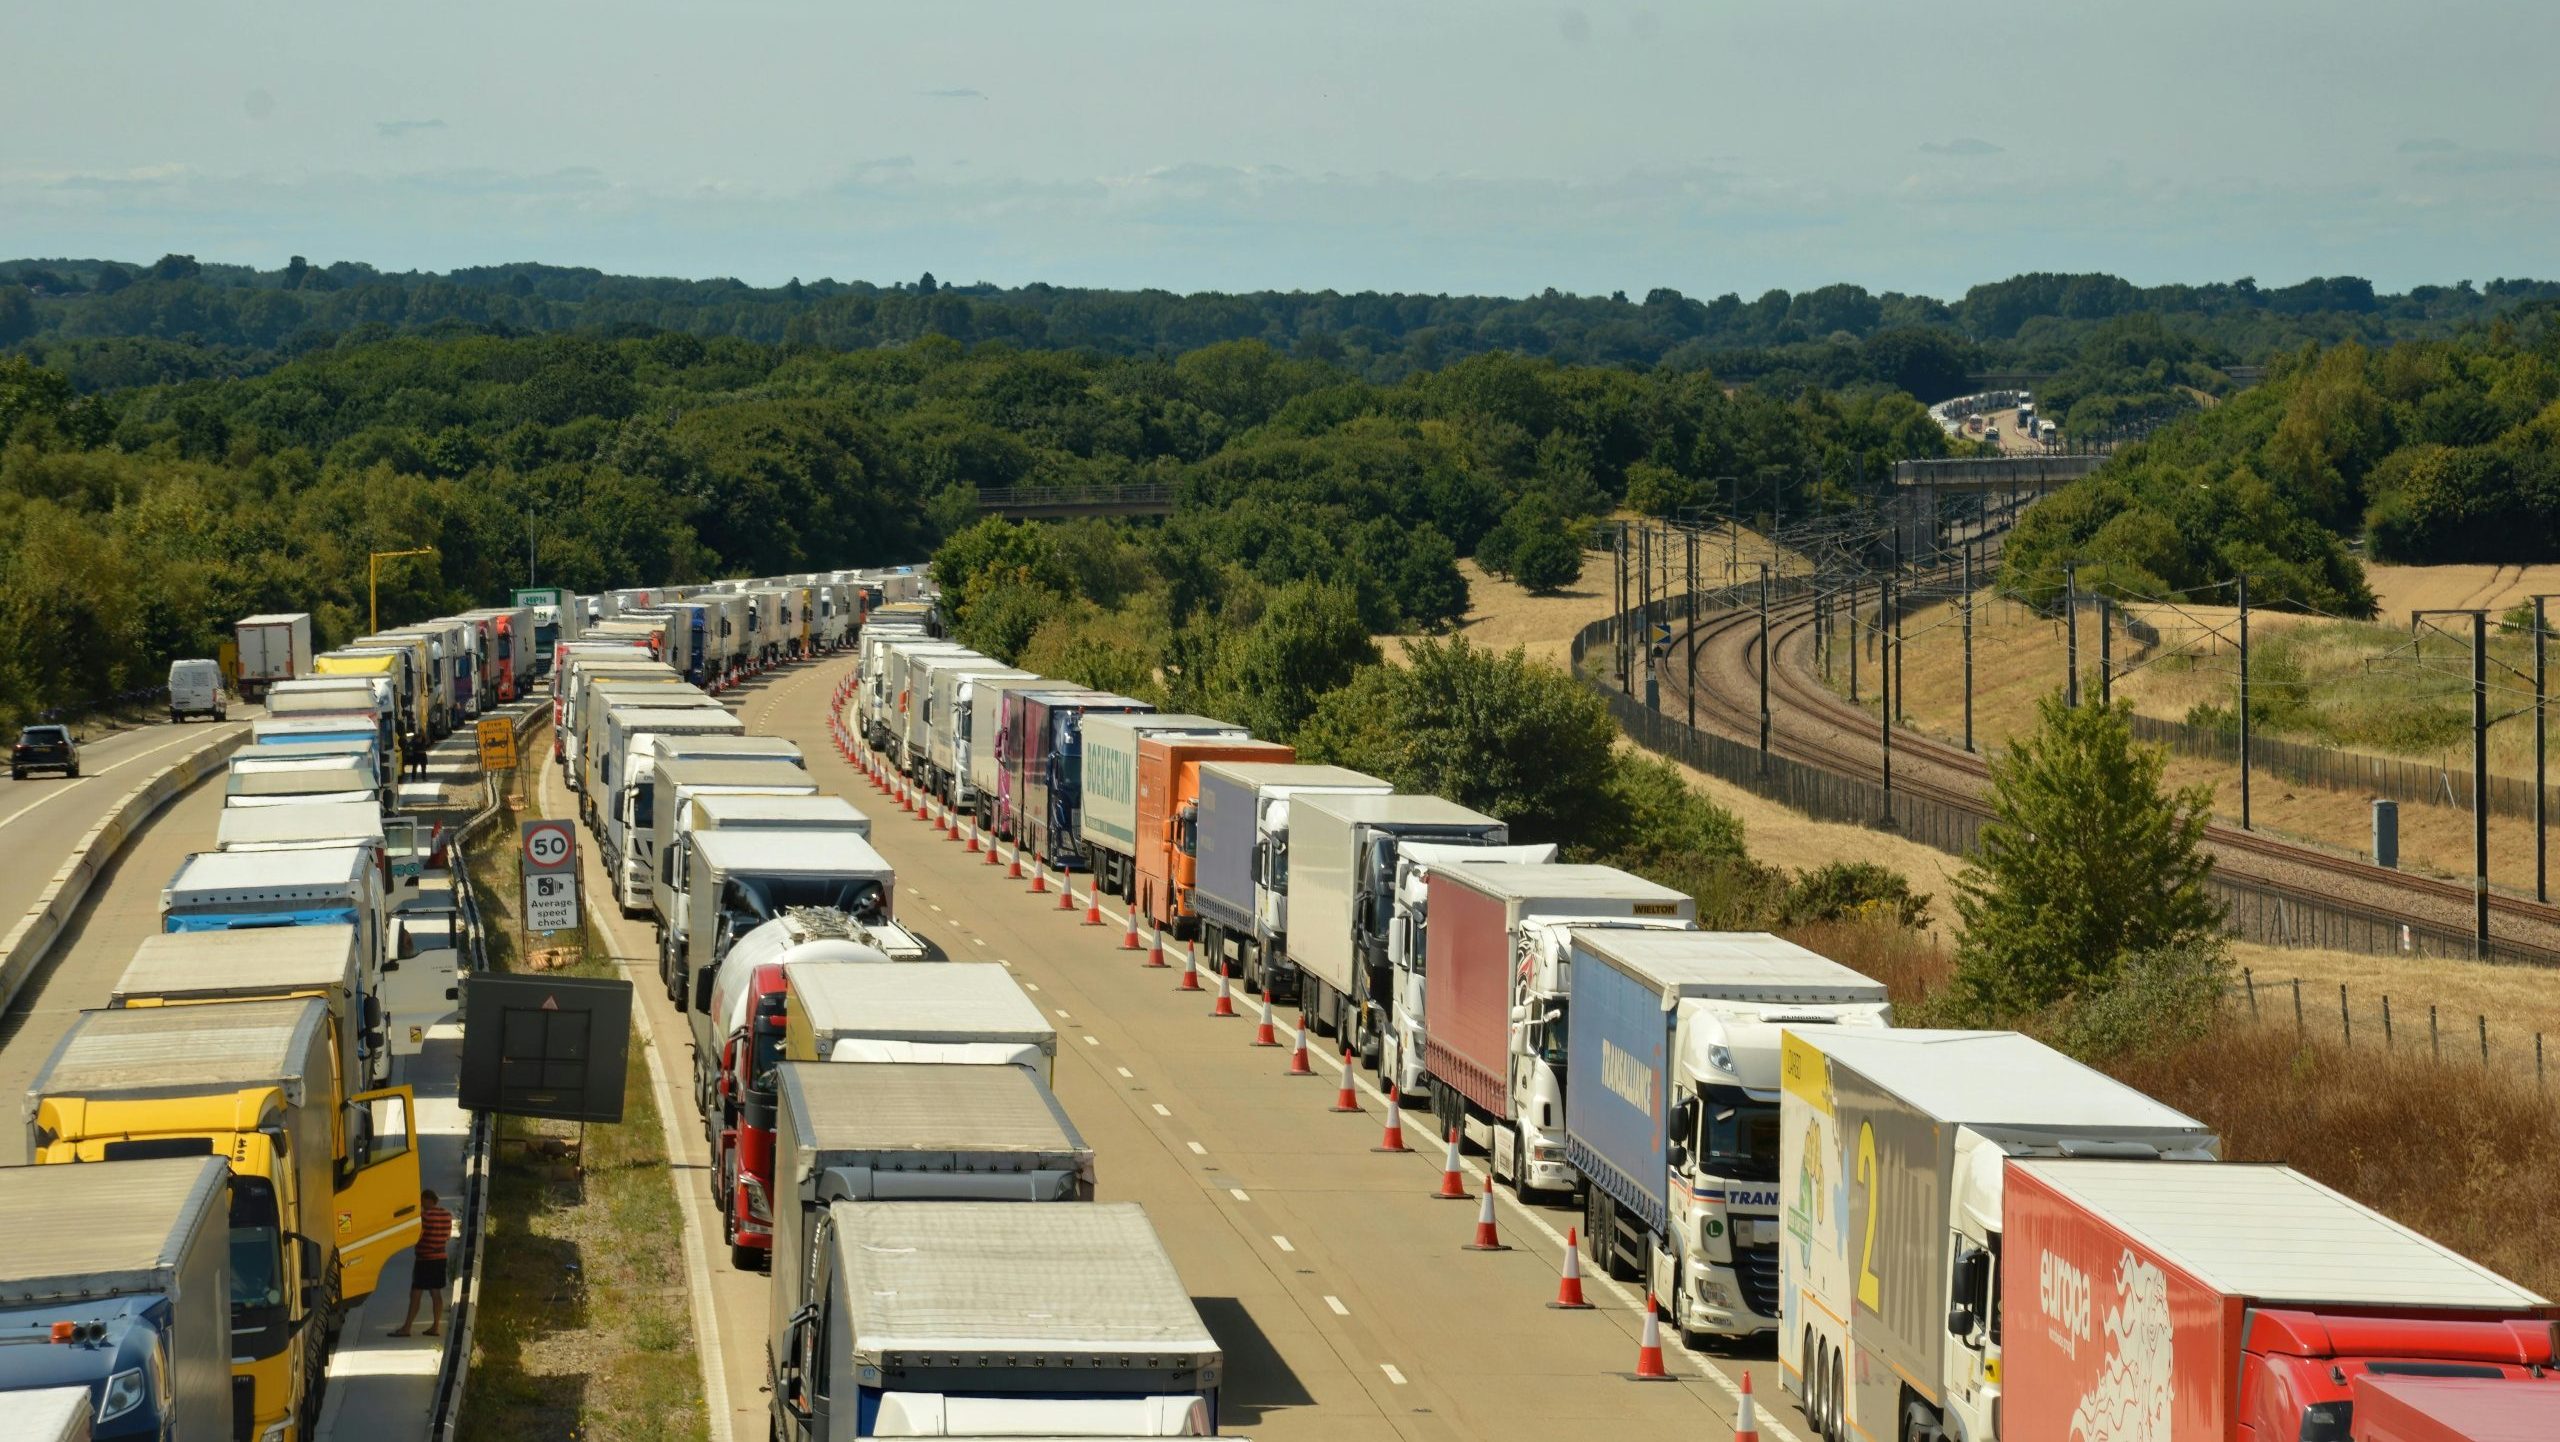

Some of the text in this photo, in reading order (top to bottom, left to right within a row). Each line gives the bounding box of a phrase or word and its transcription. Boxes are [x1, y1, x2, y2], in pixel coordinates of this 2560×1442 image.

[1087, 743, 1131, 805] BOEKESTIJN
[534, 837, 566, 856] 50
[531, 900, 573, 909] Average
[1634, 904, 1676, 914] WIELTON
[537, 909, 567, 918] speed
[537, 918, 568, 927] check
[1729, 1191, 1780, 1206] TRAN
[1710, 1223, 1719, 1236] L
[2041, 1248, 2090, 1361] europa
